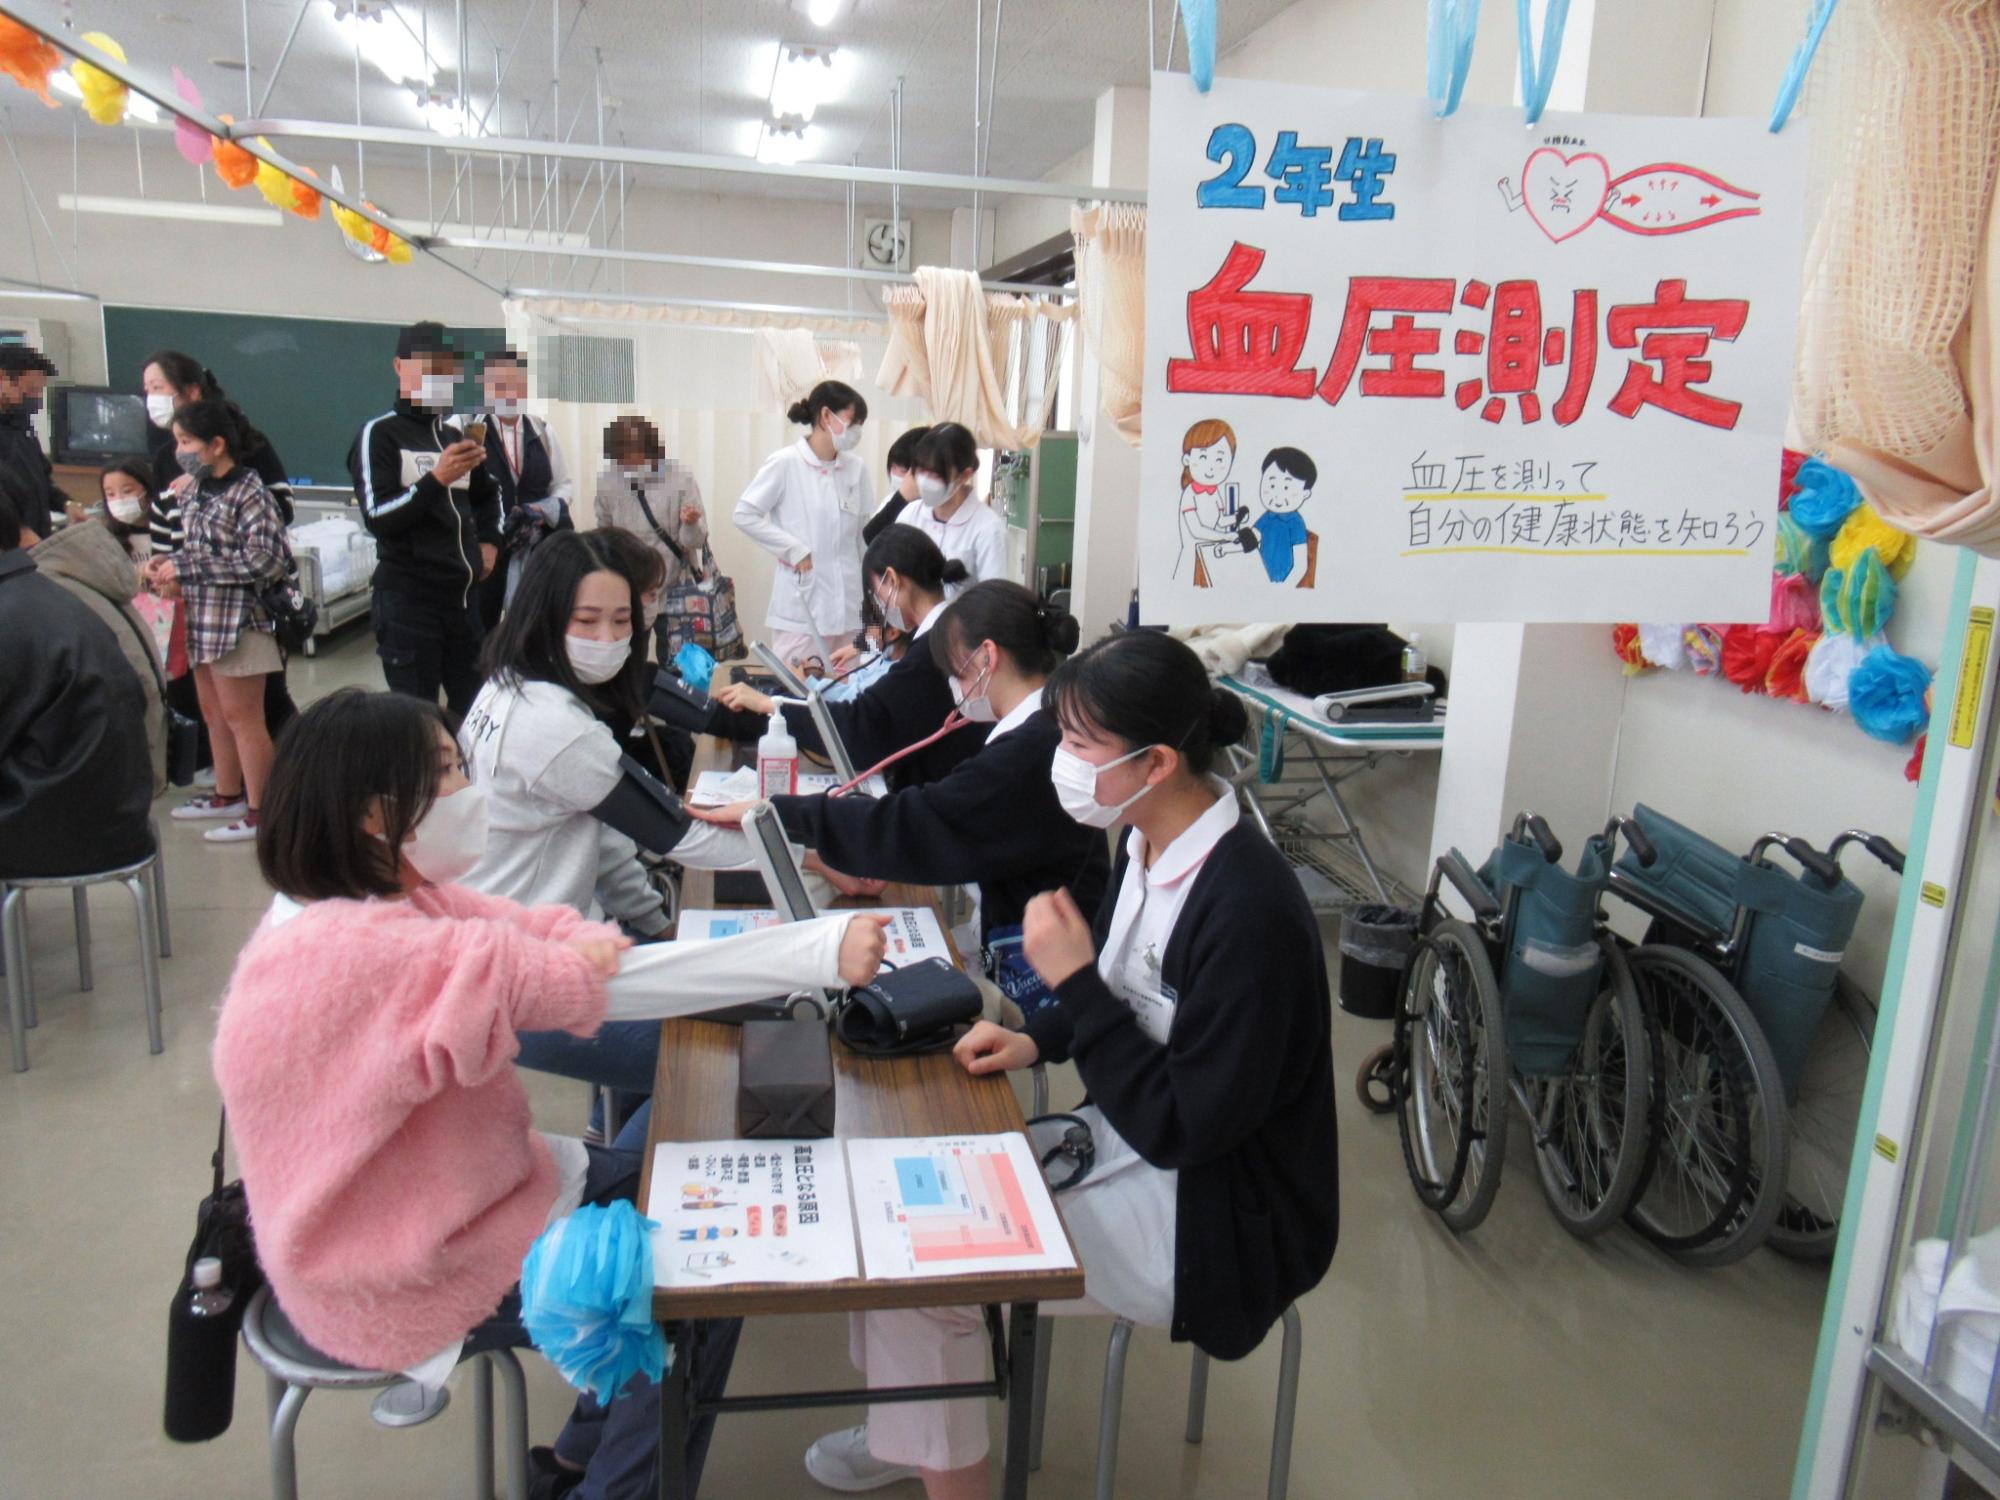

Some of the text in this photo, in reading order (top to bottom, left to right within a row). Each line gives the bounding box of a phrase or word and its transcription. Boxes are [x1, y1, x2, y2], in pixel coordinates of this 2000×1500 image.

[1197, 123, 1397, 221] 2年生
[1166, 240, 1750, 431] 血圧測定
[1402, 450, 1598, 494] 血圧を測って
[1408, 499, 1765, 547] 自分の健康状態を知ろう
[794, 1145, 819, 1224] 高血圧となる原因
